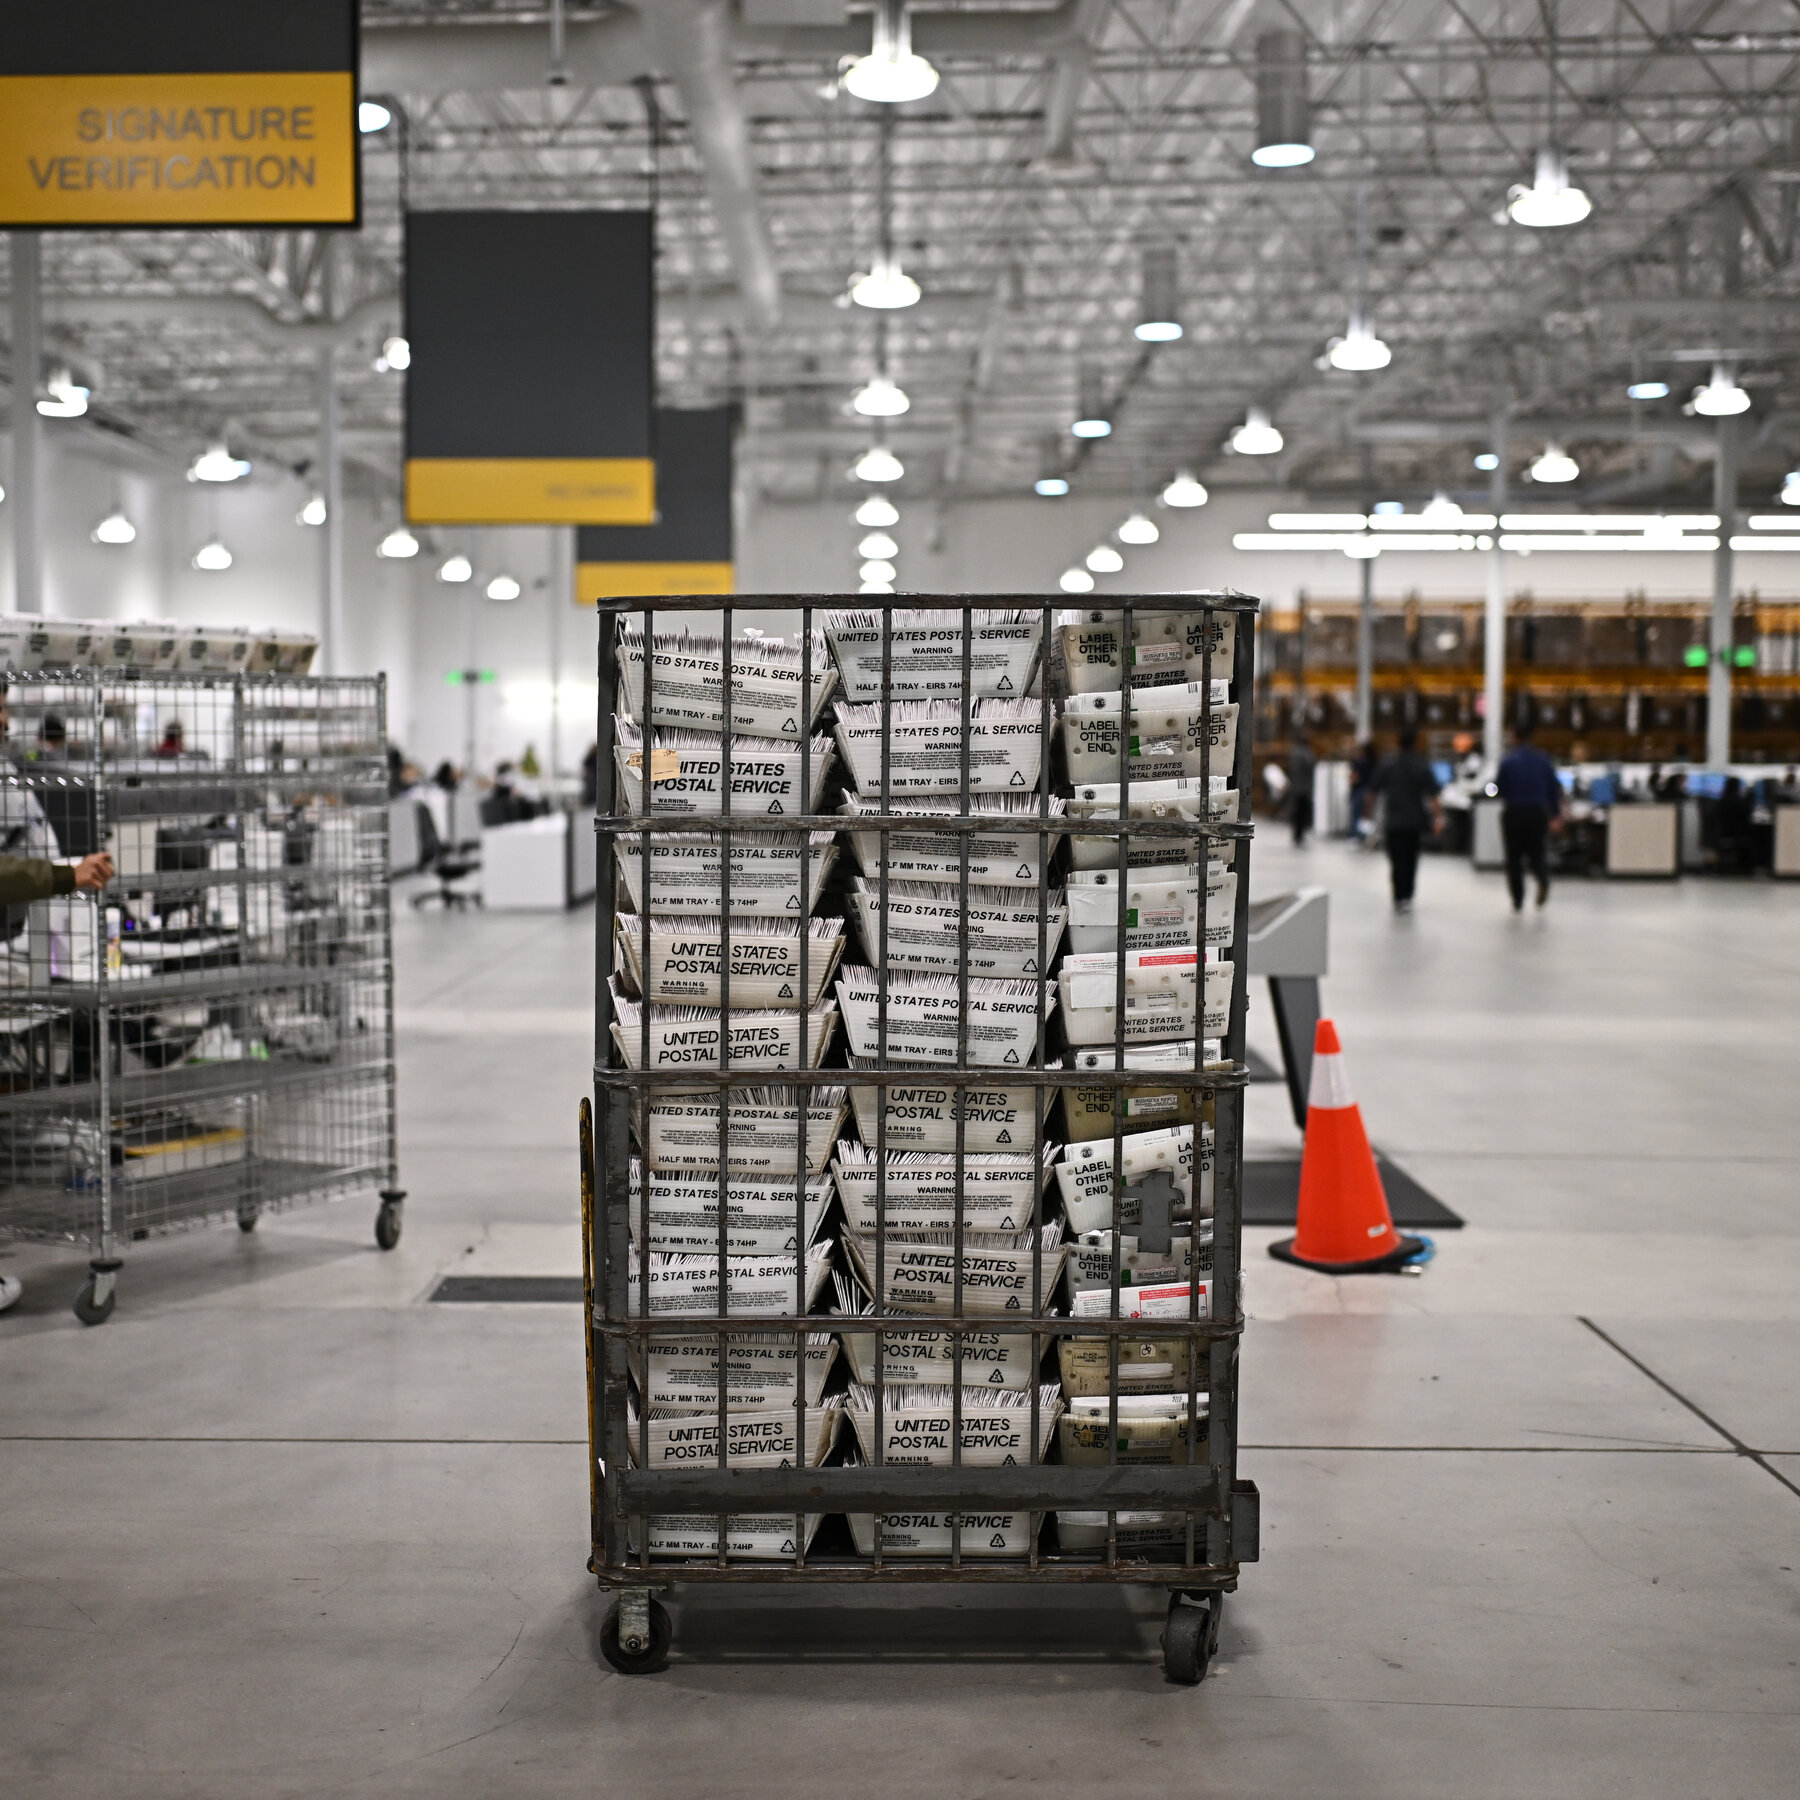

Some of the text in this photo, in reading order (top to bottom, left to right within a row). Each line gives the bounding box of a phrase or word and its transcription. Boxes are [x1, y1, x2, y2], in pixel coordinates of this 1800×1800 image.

[77, 106, 315, 142] SIGNATURE
[28, 154, 316, 190] VERIFICATION
[1187, 622, 1223, 635] LAEL
[837, 629, 1030, 642] UNITED TATES SERVICE
[1079, 634, 1117, 644] LABEL
[1079, 643, 1118, 654] OTHER
[1087, 655, 1110, 664] END
[629, 652, 822, 684] UNTED STATES OSTAL SERVCE
[1155, 670, 1186, 678] STATES
[856, 682, 946, 691] HALF TRAY EIRS
[666, 708, 755, 725] MM TRAY 74HP
[895, 724, 1043, 737] STATES SERVICE
[1080, 720, 1120, 731] LABEL
[1080, 731, 1120, 741] OTHER
[1087, 743, 1112, 752] END
[728, 762, 785, 776] STATES
[1128, 762, 1182, 771] NITED STATES
[1152, 770, 1185, 778] SERVICE
[653, 778, 791, 794] POSTAL ERVICE
[909, 778, 931, 786] TRAY
[939, 777, 958, 785] EIRS
[627, 847, 821, 859] UNTED STATES OSTAL SERVCE
[1156, 848, 1186, 856] STATES
[875, 861, 900, 869] HLF
[900, 862, 914, 870] MM
[916, 863, 938, 871] TRAY
[1127, 856, 1188, 866] OSTAL SERVICE
[737, 898, 758, 906] 74HP
[915, 905, 960, 918] STATES
[1155, 931, 1188, 939] STATES
[1126, 939, 1191, 949] OSTAL SERVICE
[671, 943, 788, 960] UNITED STATES
[907, 954, 996, 968] MM TRAY 74HP
[664, 960, 798, 977] POSTAL SERVICE
[894, 995, 939, 1008] STATES
[1124, 1018, 1149, 1026] NITED
[1150, 1016, 1182, 1024] STATES
[1149, 1024, 1185, 1033] SERVICE
[663, 1030, 719, 1045] UNITED
[658, 1048, 718, 1064] POSTAL
[888, 1045, 902, 1053] MM
[904, 1046, 926, 1054] TRAY
[934, 1048, 953, 1056] EIRS
[891, 1089, 947, 1103] UNITED
[649, 1106, 833, 1120] NITED POSTAL SEVICE
[885, 1105, 944, 1120] POSTAL
[1086, 1103, 1110, 1113] END
[1178, 1138, 1213, 1153] LAEL
[658, 1156, 680, 1164] HALF
[682, 1156, 697, 1164] MM
[728, 1158, 747, 1166] EIRS
[749, 1158, 771, 1166] 74HP
[1075, 1161, 1111, 1175] LABEL
[887, 1171, 1034, 1181] STATES SERVICE
[1075, 1171, 1114, 1186] OTHER
[629, 1187, 718, 1199] UNTED STATES
[1085, 1185, 1108, 1197] END
[901, 1220, 924, 1228] TRAY
[930, 1220, 950, 1228] EIRS
[669, 1237, 757, 1247] MM TRAY 74HP
[901, 1253, 1017, 1272] UNITED STATES
[662, 1268, 755, 1281] STATES PSTAL
[894, 1268, 953, 1284] POSTAL
[1086, 1271, 1108, 1280] END
[729, 1348, 774, 1358] POSTAL
[882, 1343, 936, 1359] POSTAL
[678, 1395, 692, 1403] MM
[694, 1395, 716, 1403] TRAY
[744, 1396, 765, 1404] 74HP
[728, 1422, 783, 1437] STATES
[895, 1419, 950, 1432] UNITED
[728, 1438, 794, 1454] SERVICE
[889, 1436, 948, 1448] POSTAL
[666, 1541, 680, 1549] MM
